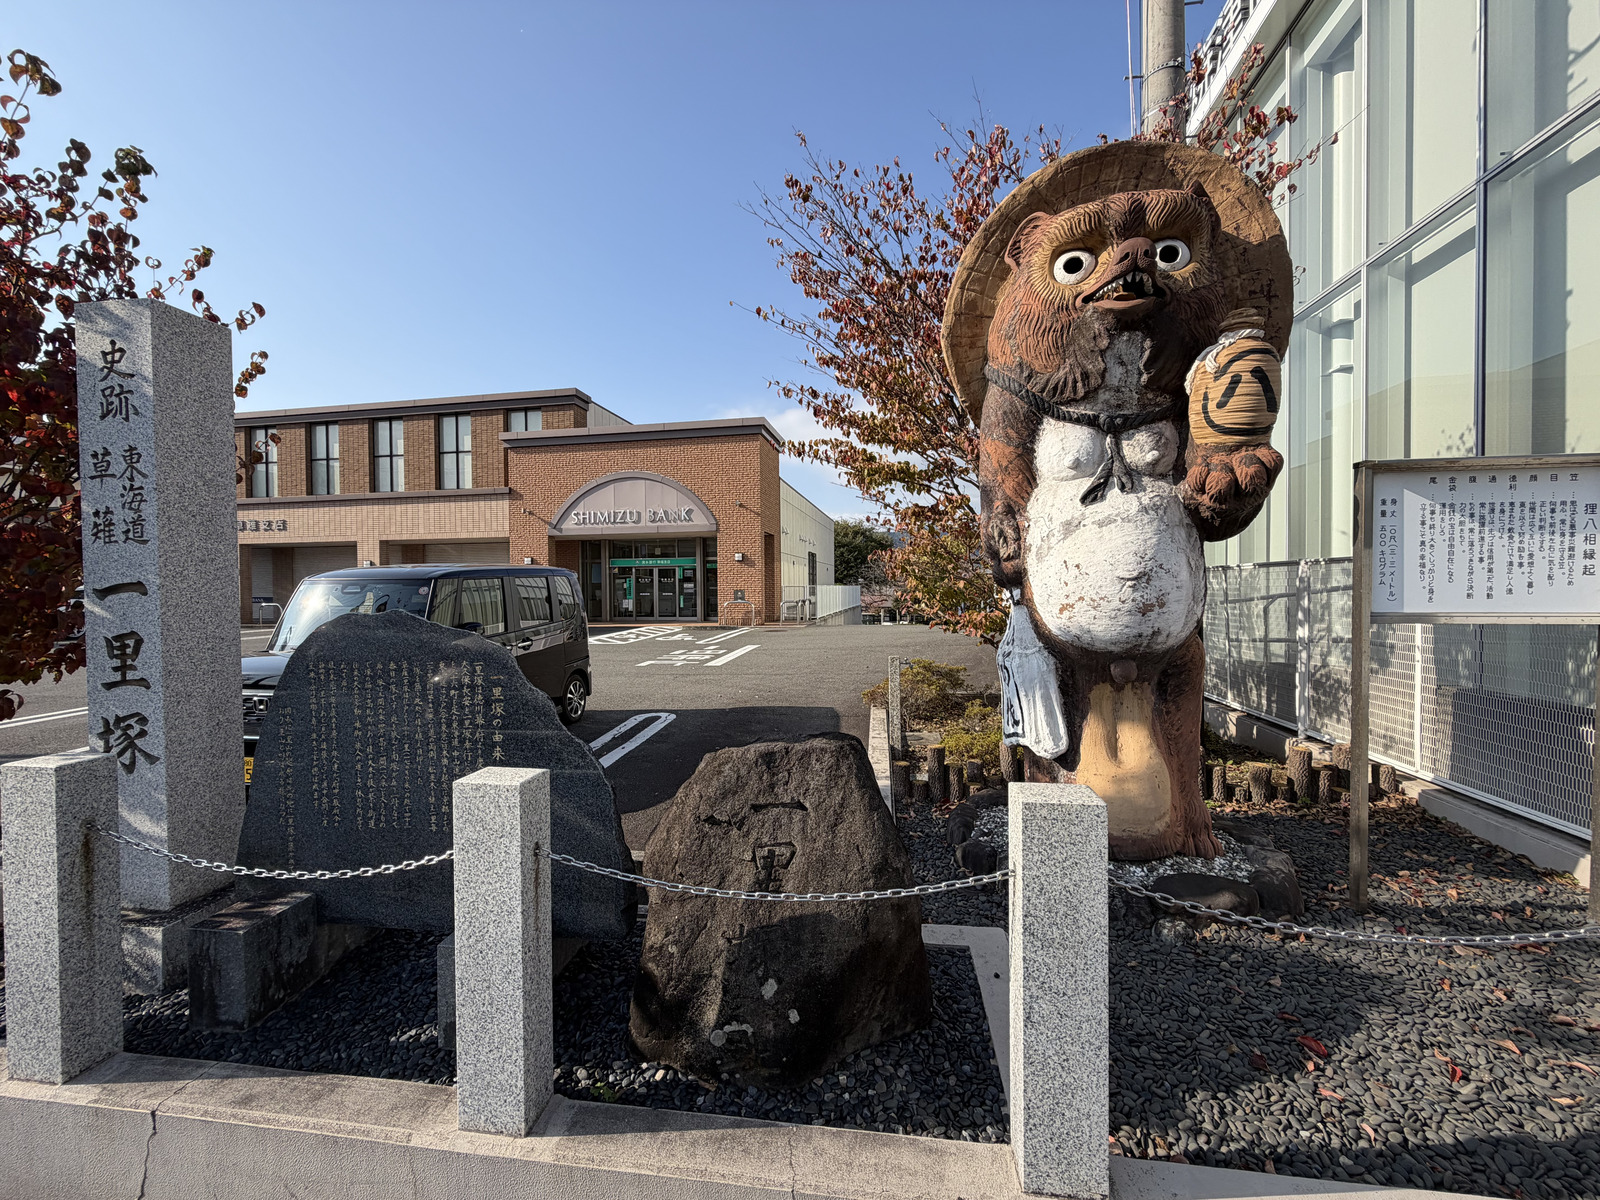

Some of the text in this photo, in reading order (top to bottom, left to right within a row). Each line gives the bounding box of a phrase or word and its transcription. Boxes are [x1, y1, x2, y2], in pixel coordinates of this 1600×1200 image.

[98, 338, 140, 423] 史跡
[87, 450, 120, 546] 草薙
[116, 444, 150, 546] 東海道
[571, 506, 692, 525] SHIMIZU BANK
[1582, 503, 1597, 577] 狸八相縁起
[91, 580, 162, 777] 一里塚
[490, 676, 506, 761] 一里塚の由来
